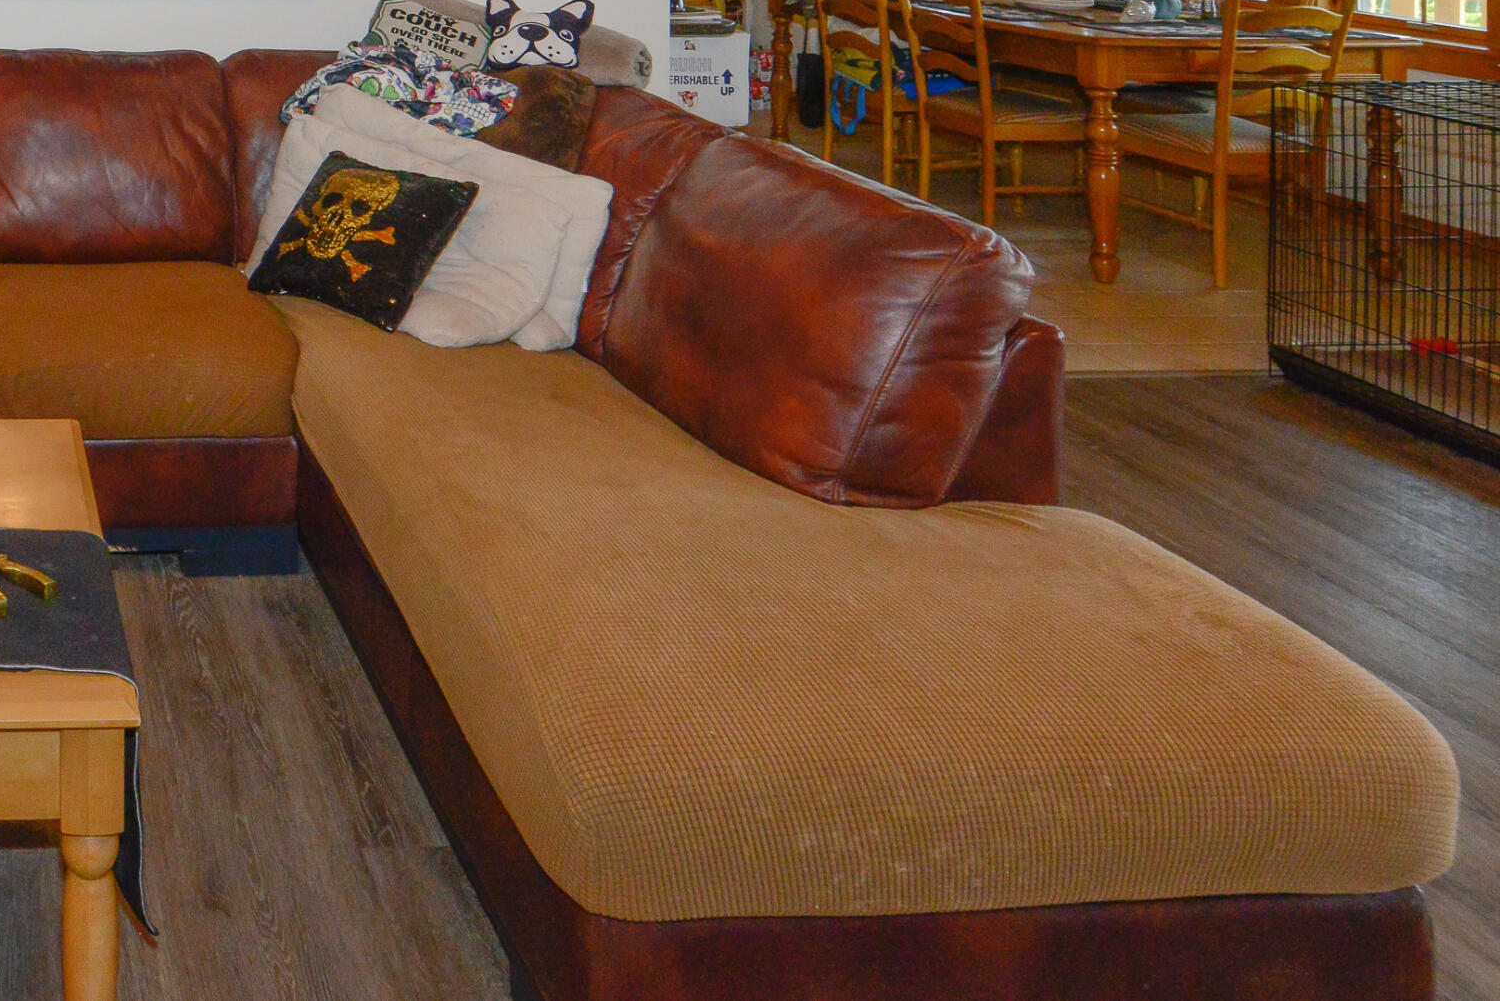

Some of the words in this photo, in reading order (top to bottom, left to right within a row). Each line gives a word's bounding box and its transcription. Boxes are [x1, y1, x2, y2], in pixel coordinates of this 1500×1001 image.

[389, 8, 478, 48] COUCH
[411, 26, 428, 37] GO
[431, 33, 453, 46] SIT
[390, 26, 424, 44] OVER
[427, 39, 468, 60] THERE
[720, 86, 735, 96] UP
